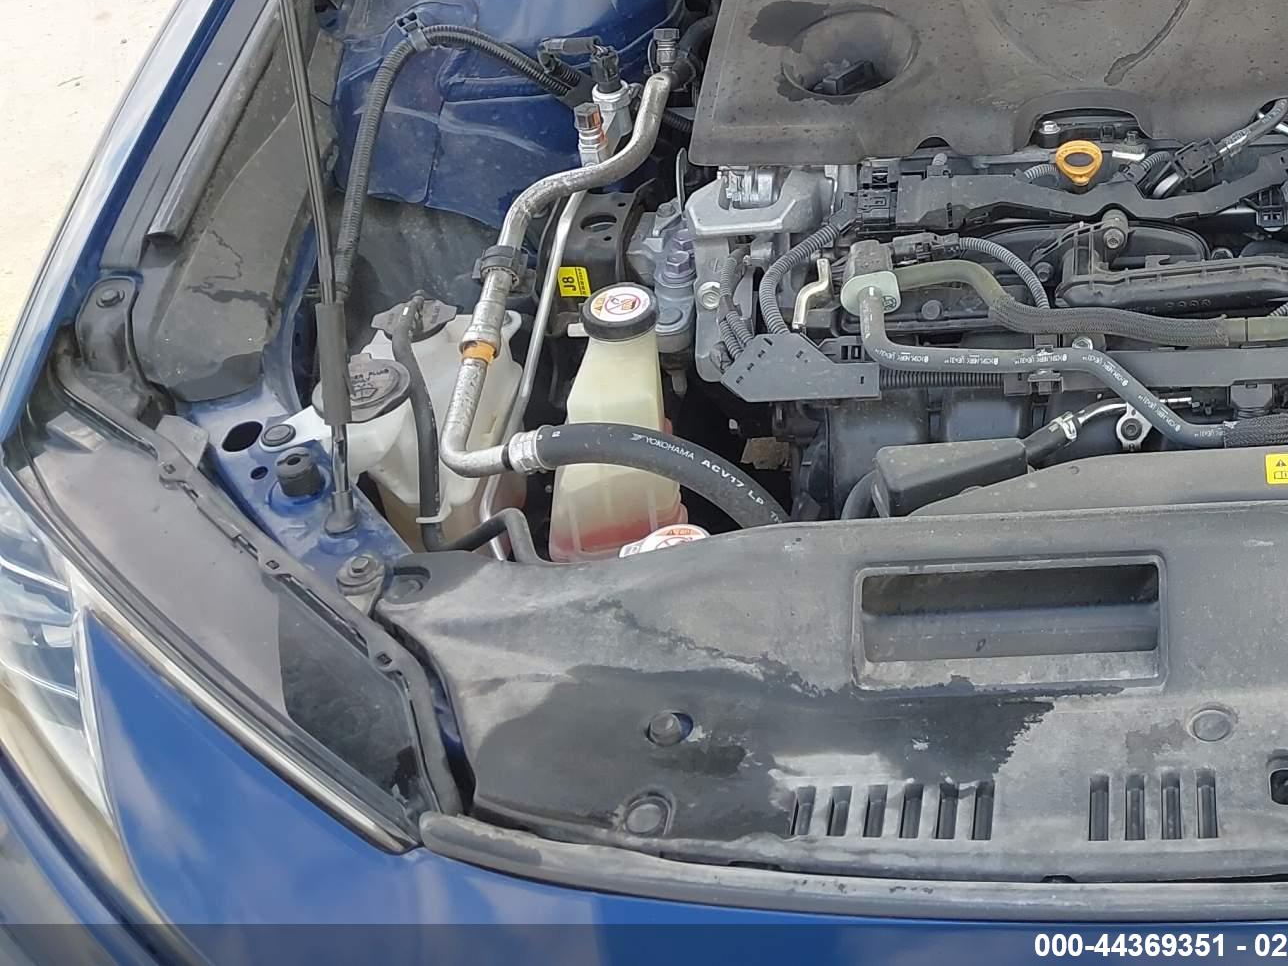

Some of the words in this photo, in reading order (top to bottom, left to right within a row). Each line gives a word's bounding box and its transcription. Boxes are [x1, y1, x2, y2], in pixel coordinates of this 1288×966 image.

[561, 276, 577, 292] J8
[642, 435, 694, 461] YOKOHAMA
[701, 459, 745, 488] ACV17
[748, 489, 764, 505] LP
